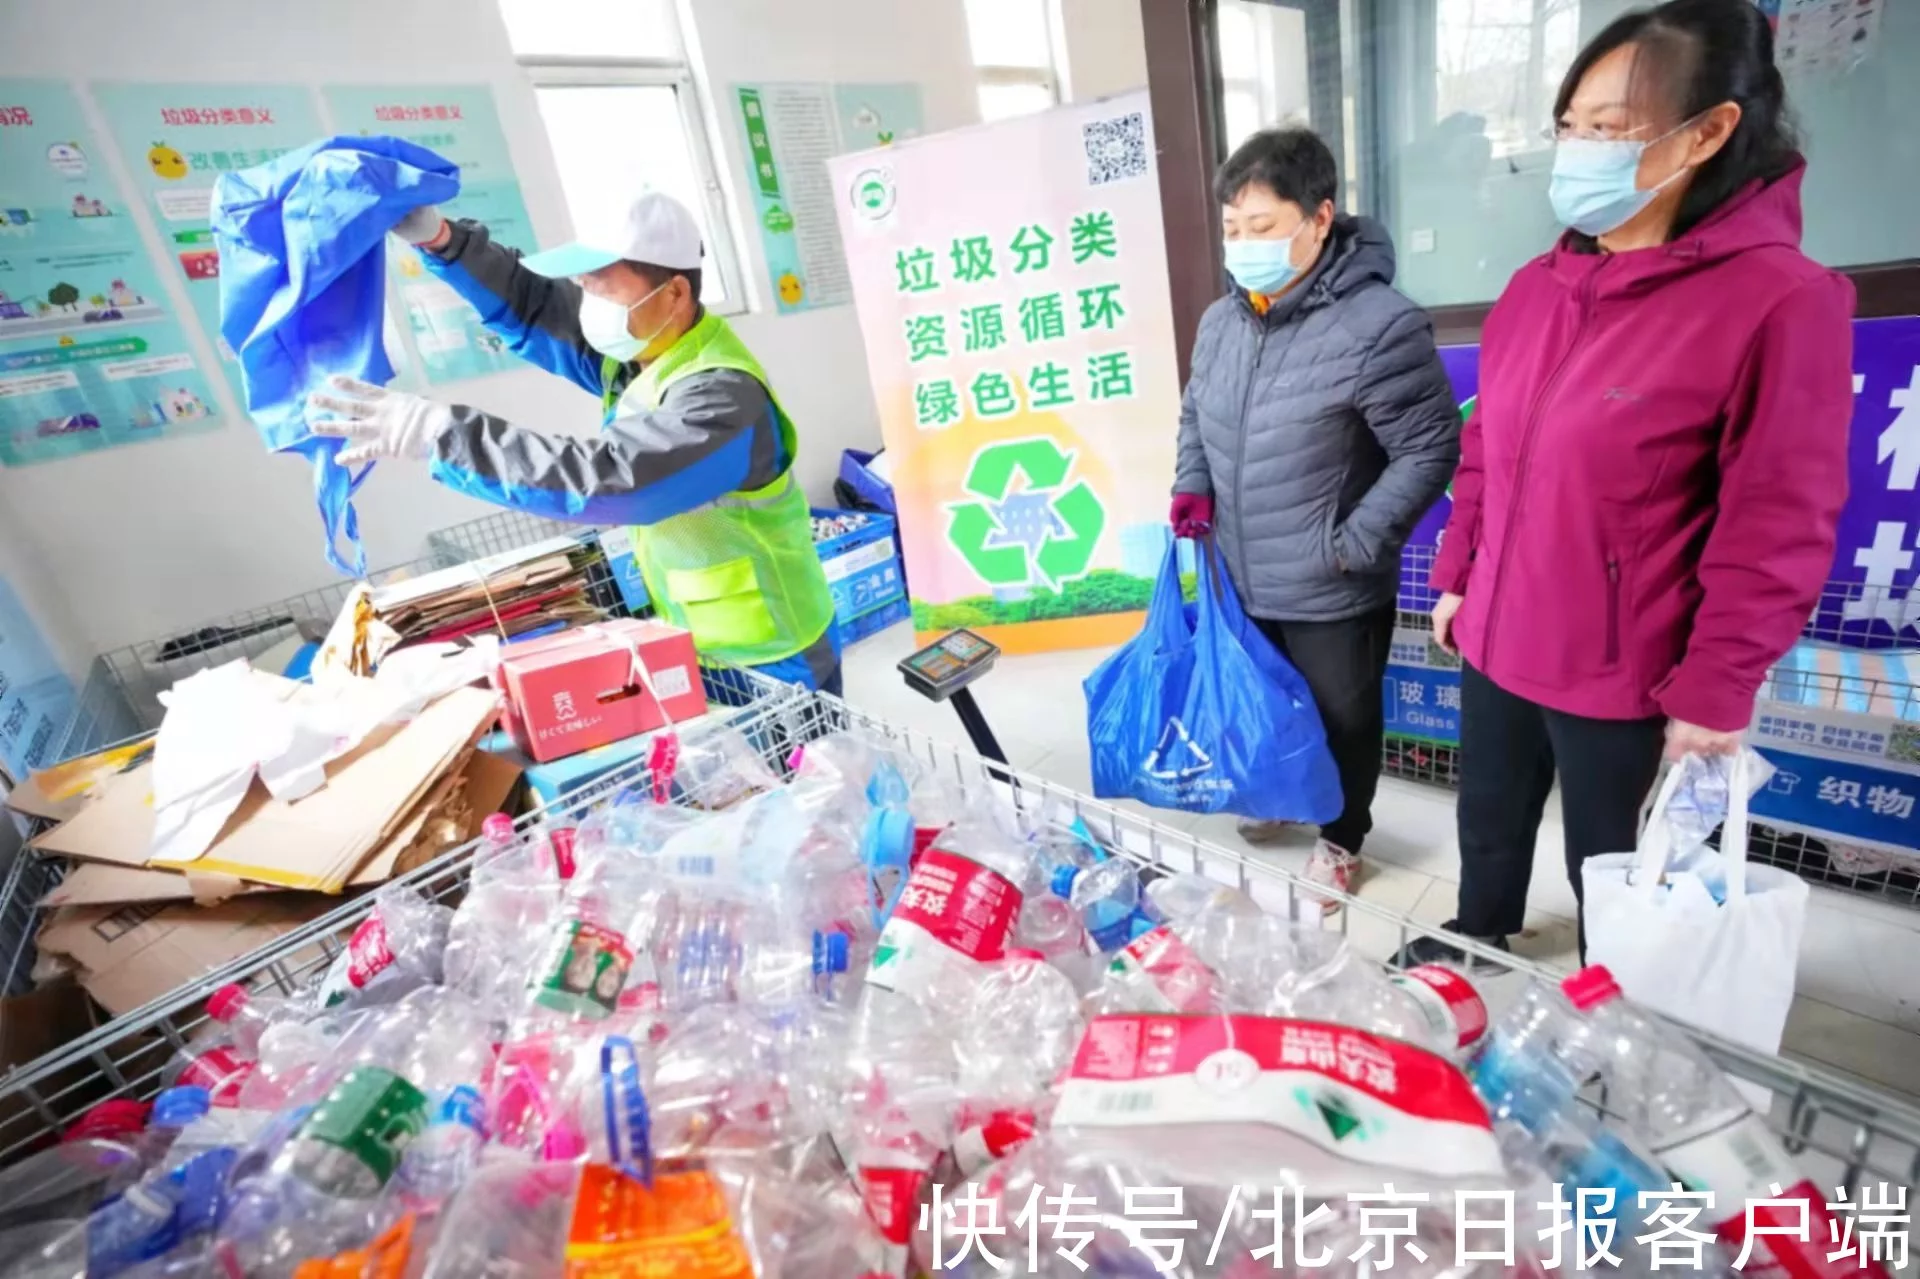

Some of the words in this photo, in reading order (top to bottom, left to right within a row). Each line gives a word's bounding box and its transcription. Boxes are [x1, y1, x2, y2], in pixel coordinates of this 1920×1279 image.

[161, 107, 275, 126] 垃圾分类意义
[375, 104, 463, 121] 垃圾分类意义
[895, 210, 1118, 293] 垃圾分类
[904, 283, 1126, 362] 资源循环
[915, 351, 1134, 425] 绿色生活
[1399, 680, 1461, 710] 玻璃
[1406, 711, 1456, 730] Glass
[1816, 775, 1916, 819] 织物
